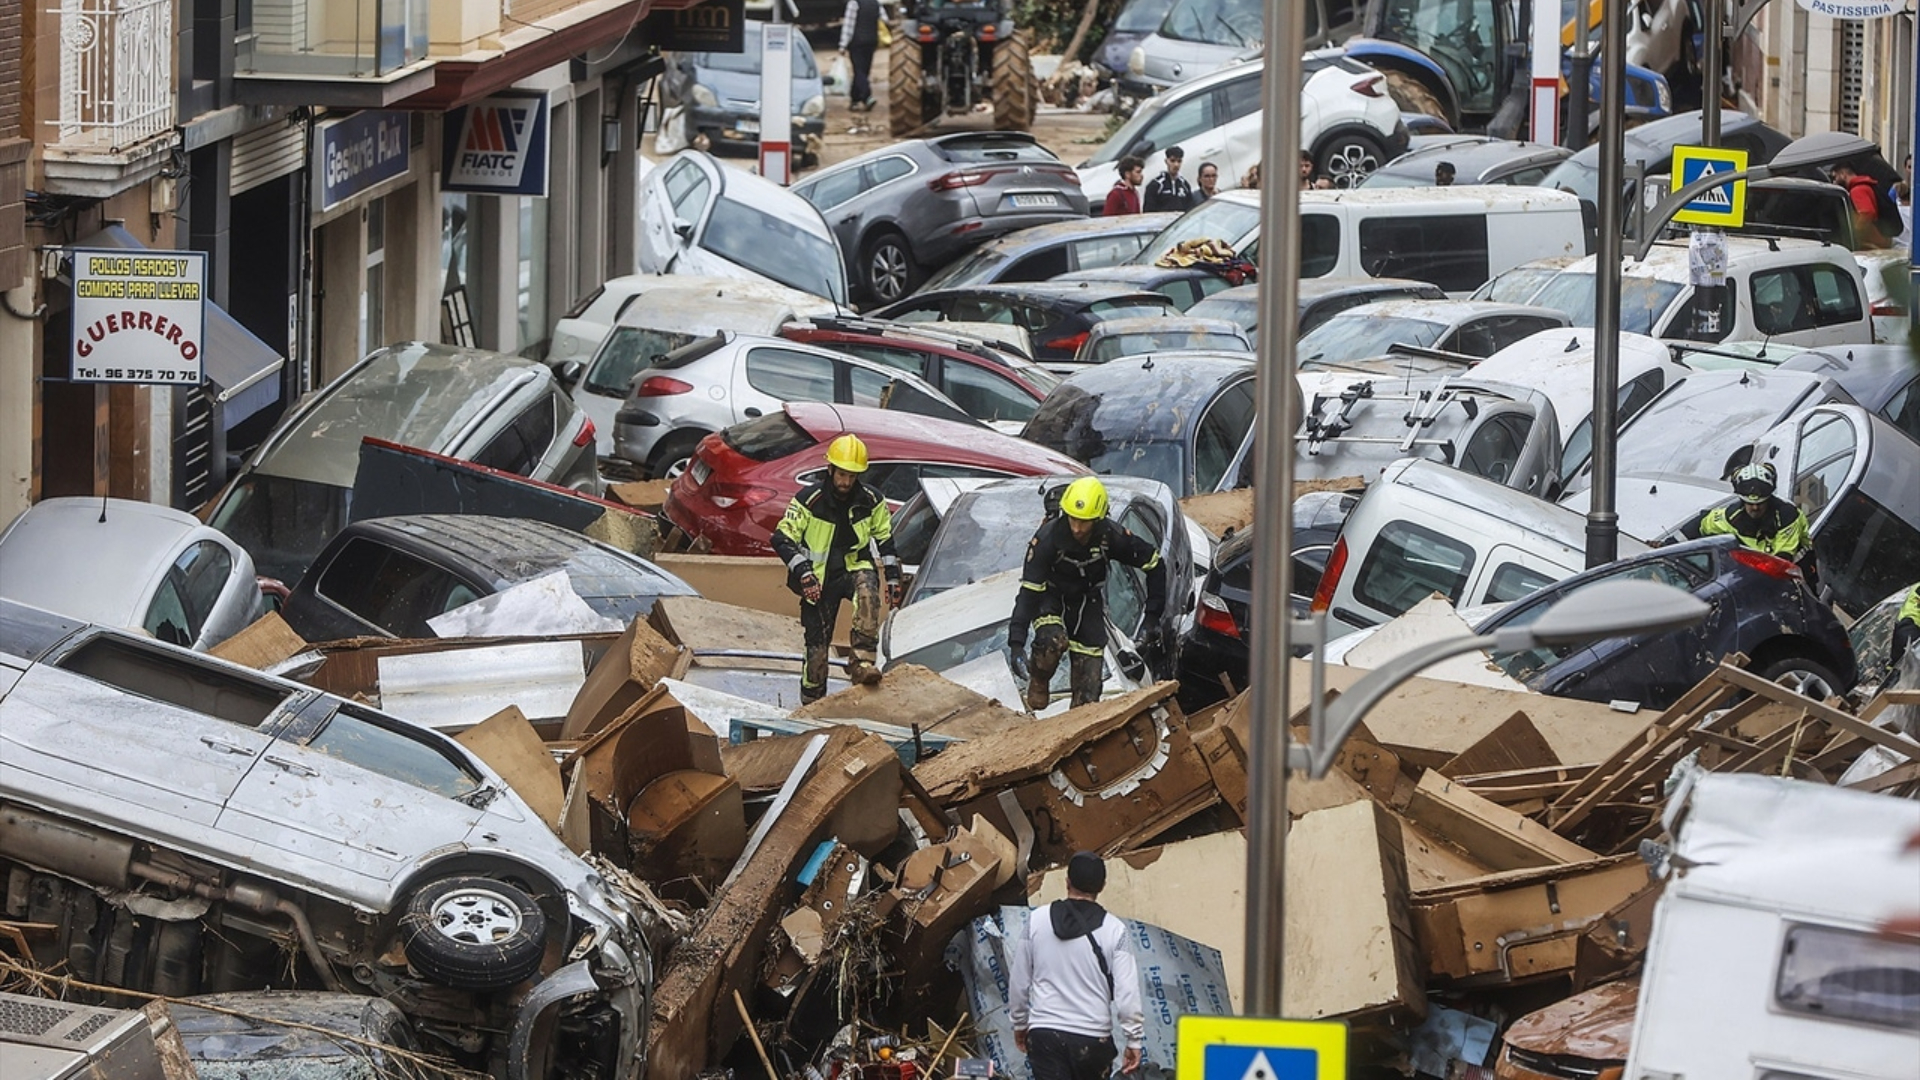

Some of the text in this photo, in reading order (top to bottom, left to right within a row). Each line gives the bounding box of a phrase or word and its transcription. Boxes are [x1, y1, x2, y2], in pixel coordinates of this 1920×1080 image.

[1812, 0, 1891, 16] PASTISSERIA
[461, 153, 515, 170] FIATC
[90, 257, 188, 277] POLLOS ASADOS Y
[77, 280, 200, 300] COMIDAS PARA LLEVAR
[77, 310, 198, 361] GUERRERO
[78, 368, 197, 381] Tel. 96 375 70 76
